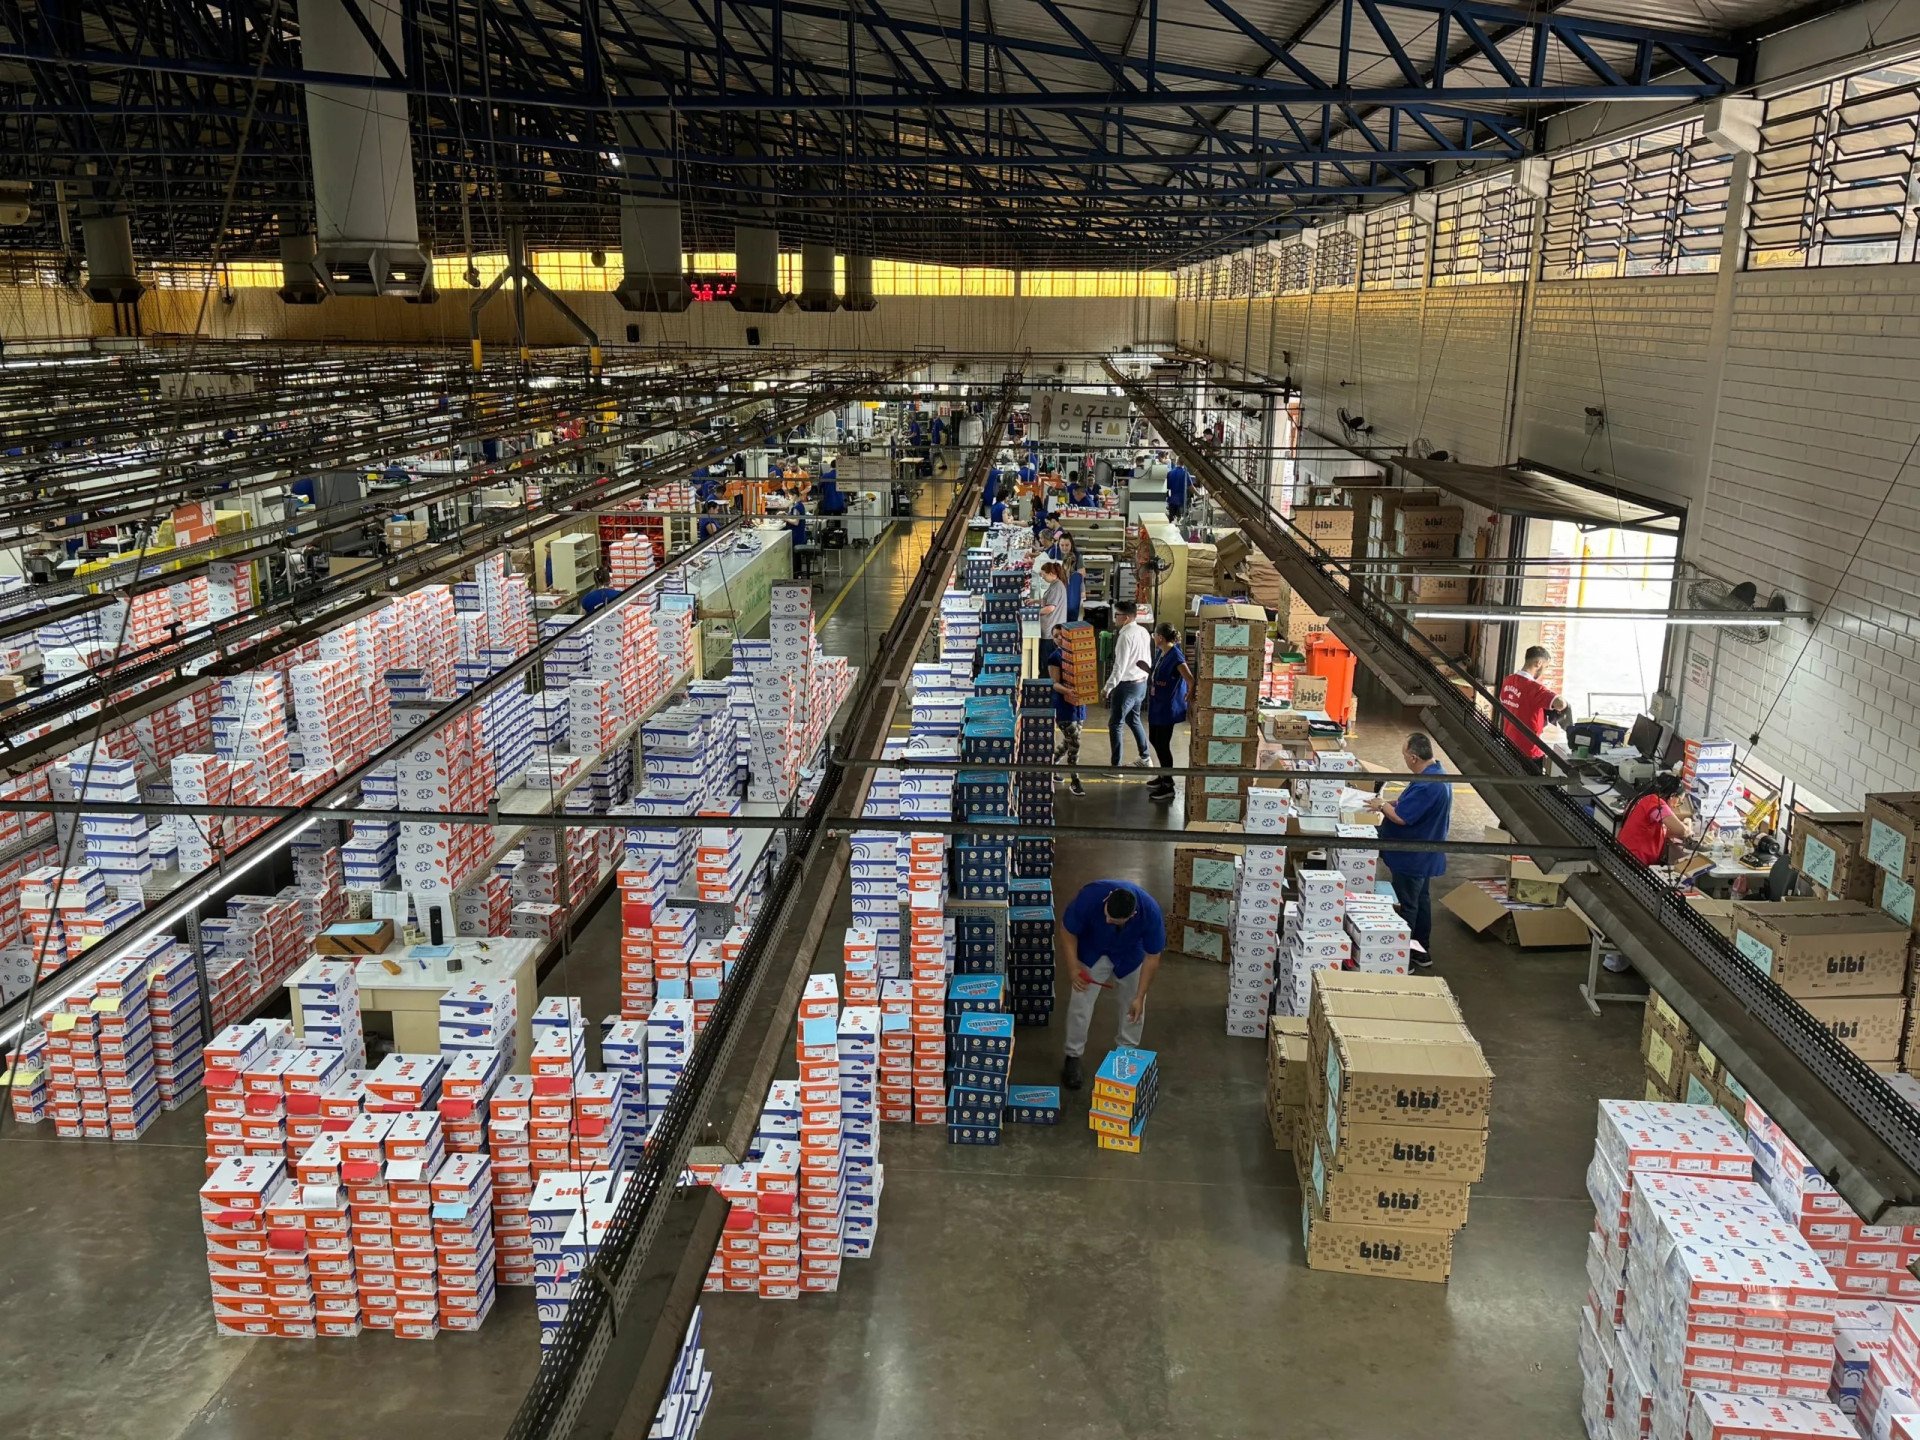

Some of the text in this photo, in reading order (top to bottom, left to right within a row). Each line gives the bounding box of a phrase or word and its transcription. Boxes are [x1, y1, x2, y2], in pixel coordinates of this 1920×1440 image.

[1061, 403, 1123, 418] FAZER
[1315, 521, 1332, 529] bibi
[1827, 956, 1865, 973] bibi
[227, 1033, 244, 1042] bibi
[266, 1057, 283, 1067] bibi
[306, 1057, 323, 1067] bibi
[469, 1059, 481, 1071] bibi
[396, 1062, 416, 1077] bibi
[1396, 1090, 1438, 1109] bibi
[1617, 1105, 1632, 1116] bibi
[1657, 1107, 1672, 1118] bibi
[1696, 1109, 1712, 1120] bibi
[363, 1122, 378, 1133] bibi
[406, 1120, 421, 1131] bibi
[1636, 1130, 1652, 1143] bibi
[1677, 1132, 1693, 1145] bibi
[1717, 1134, 1733, 1147] bibi
[1393, 1143, 1435, 1162] bibi
[234, 1166, 255, 1182] bibi
[453, 1162, 469, 1175] bibi
[1652, 1178, 1667, 1191] bibi
[1694, 1182, 1710, 1194] bibi
[555, 1187, 588, 1197] bibi
[1737, 1186, 1753, 1198] bibi
[1378, 1191, 1419, 1209] bibi
[1680, 1222, 1696, 1235] bibi
[1724, 1224, 1742, 1238] bibi
[1771, 1229, 1789, 1242] bibi
[1360, 1241, 1400, 1261] bibi
[1700, 1256, 1718, 1273] bibi
[1748, 1258, 1766, 1275] bibi
[1795, 1262, 1814, 1278] bibi
[1720, 1403, 1738, 1419] bibi
[1767, 1407, 1787, 1423] bibi
[1815, 1411, 1836, 1428] bibi
